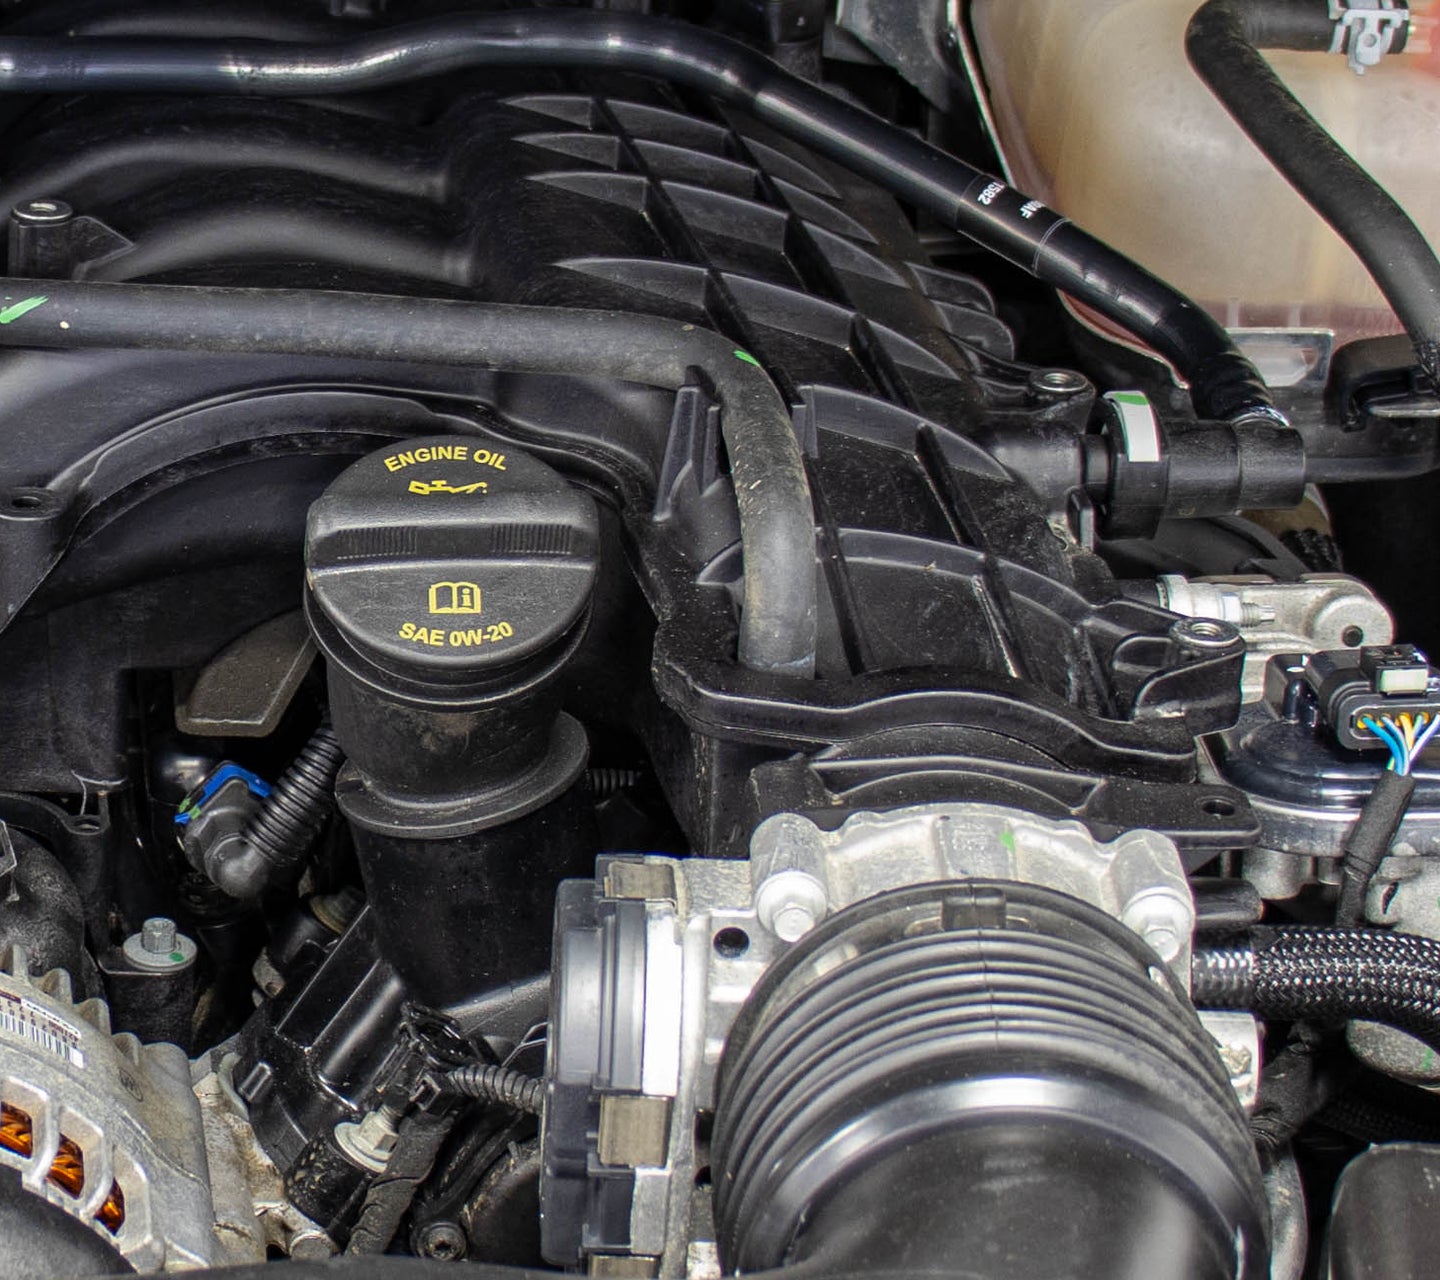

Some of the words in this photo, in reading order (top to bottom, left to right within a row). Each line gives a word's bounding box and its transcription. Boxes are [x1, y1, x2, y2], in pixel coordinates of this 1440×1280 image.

[383, 445, 469, 473] ENGINE
[473, 449, 508, 471] OIL
[399, 622, 445, 646] SAE
[449, 621, 514, 646] 0W-20
